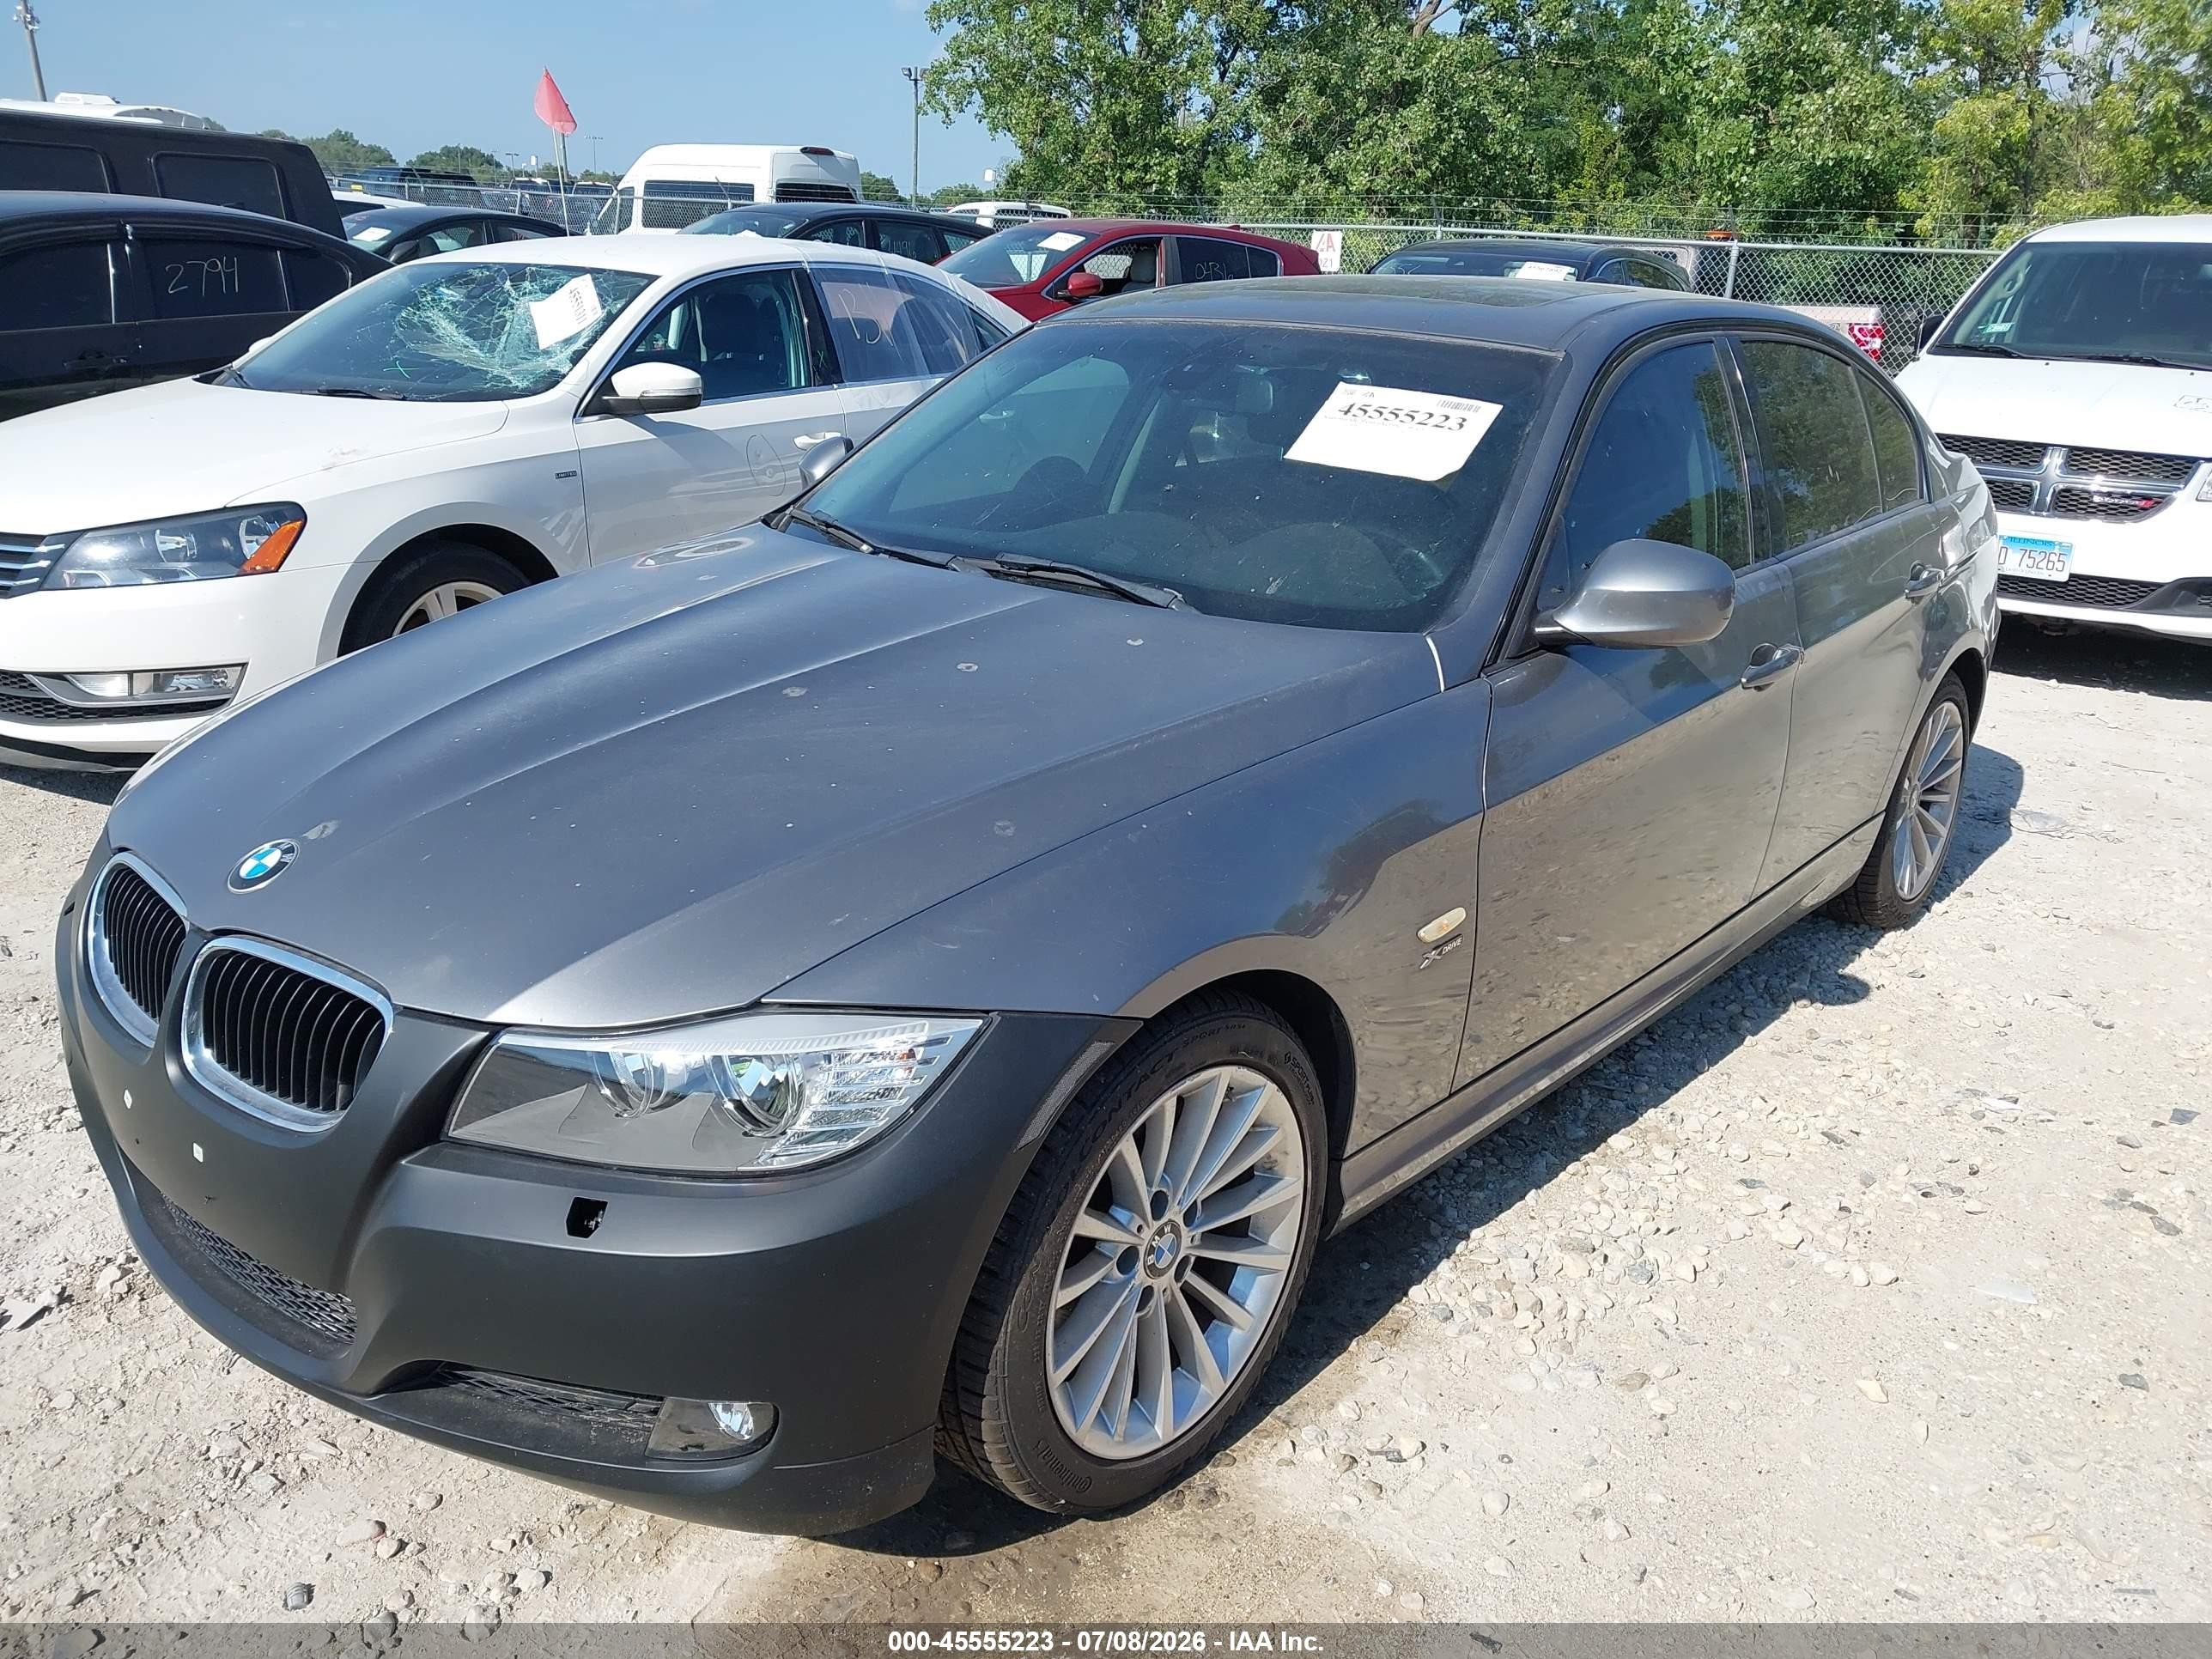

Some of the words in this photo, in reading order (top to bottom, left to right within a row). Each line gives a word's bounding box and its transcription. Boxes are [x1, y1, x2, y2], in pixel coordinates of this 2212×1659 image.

[165, 255, 239, 296] 2794
[1338, 402, 1468, 431] 45555223
[2019, 548, 2069, 572] 75265
[1147, 1223, 1172, 1266] BMW
[1036, 1443, 1093, 1494] Continental
